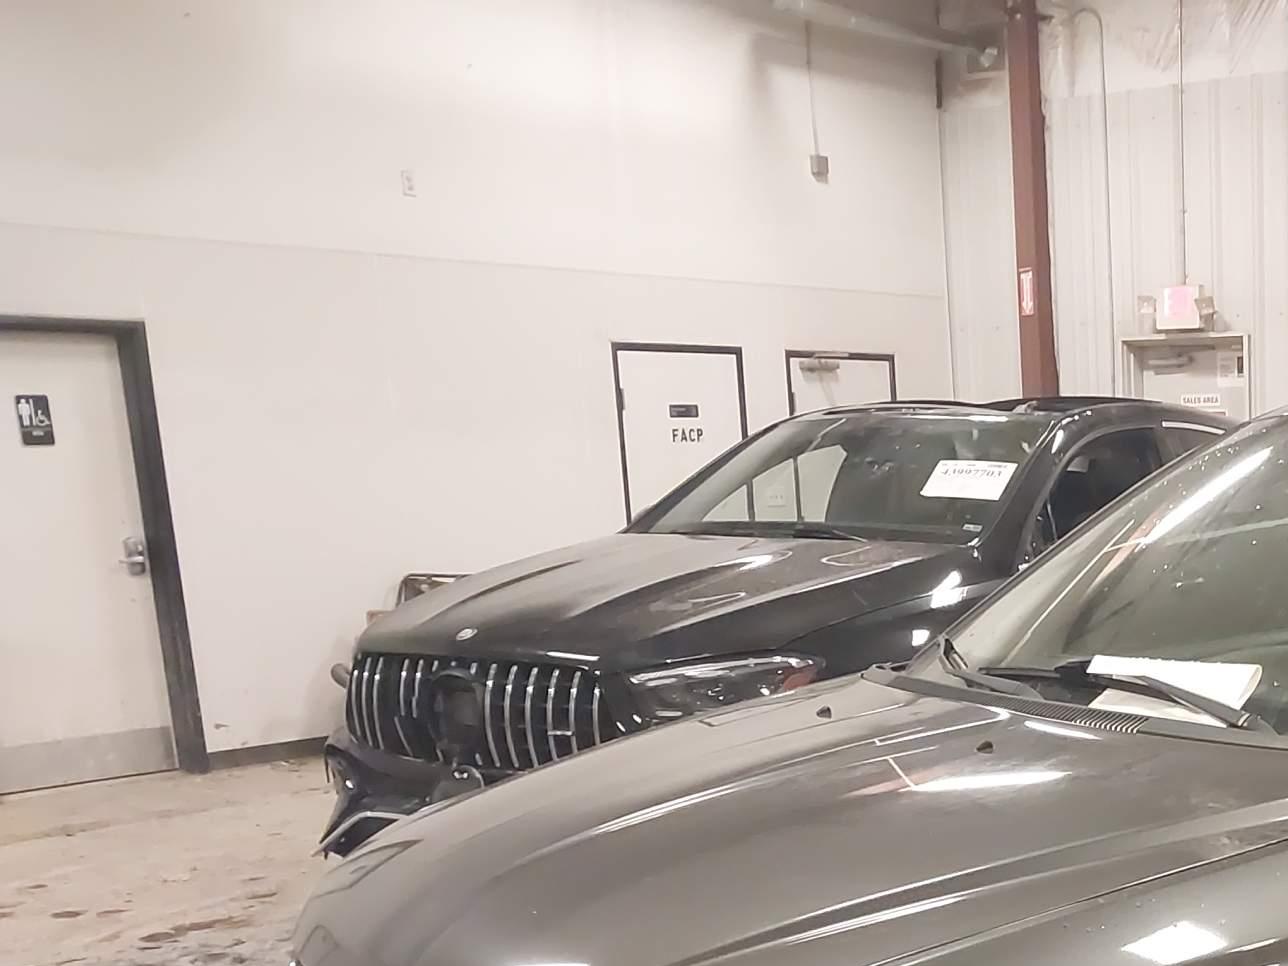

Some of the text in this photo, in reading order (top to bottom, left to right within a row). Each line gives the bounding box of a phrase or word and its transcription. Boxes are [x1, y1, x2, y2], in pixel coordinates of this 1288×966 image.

[1182, 396, 1219, 404] SALES AREA
[671, 427, 704, 443] FACP
